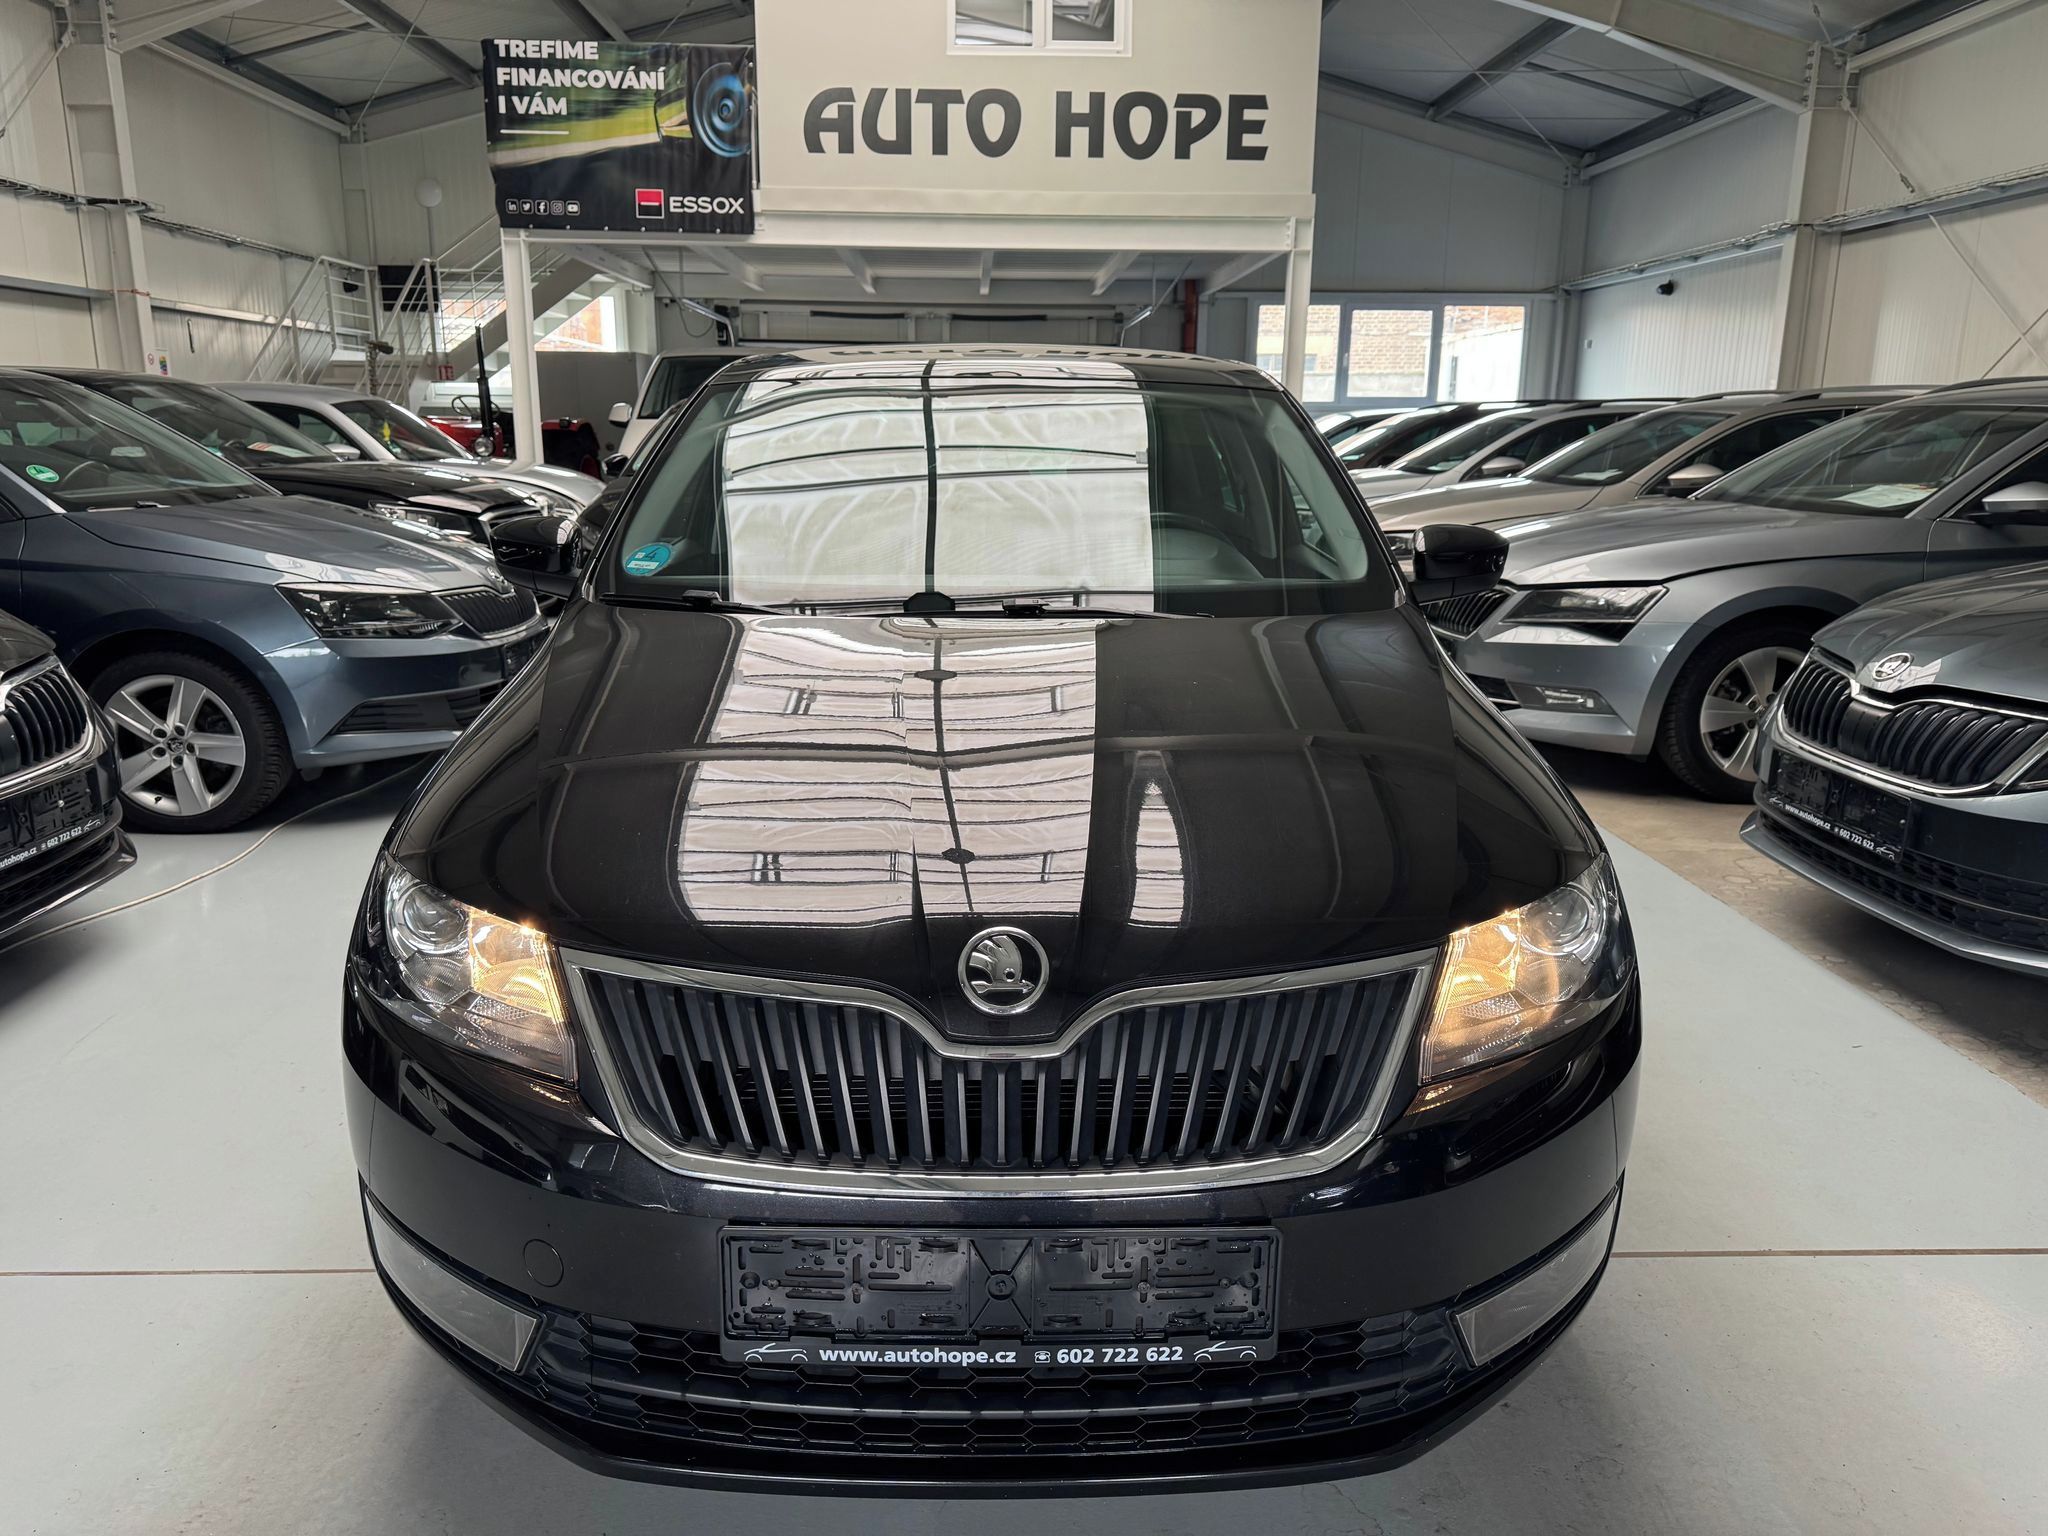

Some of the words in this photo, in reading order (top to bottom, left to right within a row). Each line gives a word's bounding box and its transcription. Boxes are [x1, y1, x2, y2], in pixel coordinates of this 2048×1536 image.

[494, 38, 599, 60] TREFIME
[496, 65, 666, 91] FINANCOVÁNÍ
[498, 95, 506, 114] I
[511, 92, 568, 116] VÁM
[803, 87, 1022, 158] AUTO
[1055, 90, 1269, 161] HOPE
[669, 196, 745, 215] ESSOX
[0, 847, 37, 868] utohope.cz
[819, 1347, 1016, 1367] www.autohope.cz
[1056, 1348, 1095, 1363] 602
[1102, 1347, 1139, 1362] 722
[1146, 1346, 1183, 1361] 622
